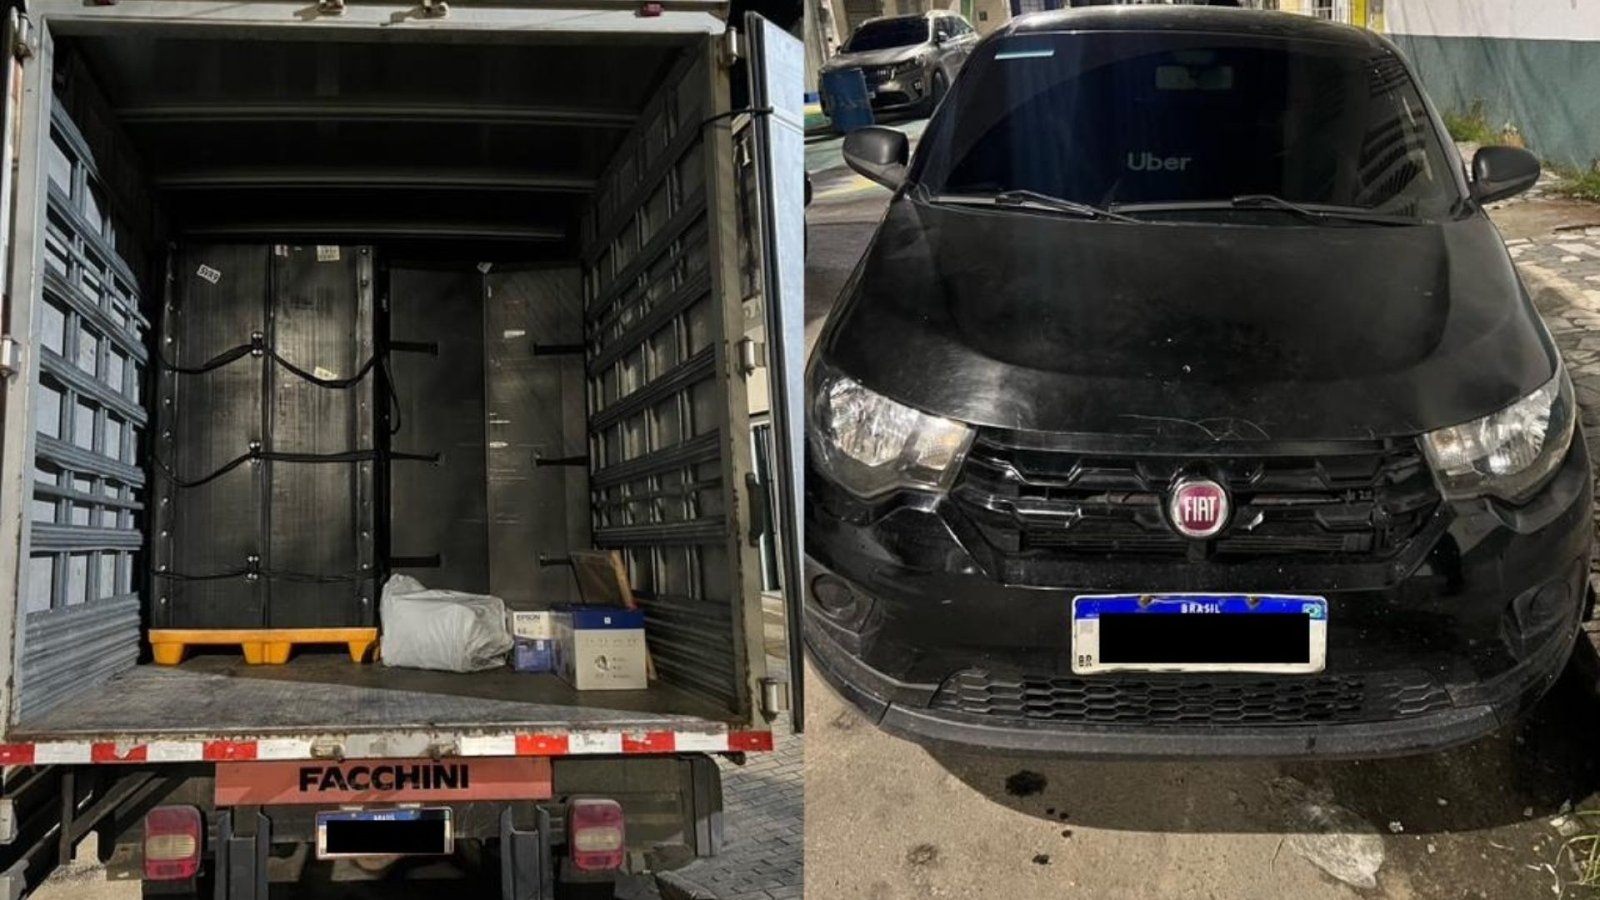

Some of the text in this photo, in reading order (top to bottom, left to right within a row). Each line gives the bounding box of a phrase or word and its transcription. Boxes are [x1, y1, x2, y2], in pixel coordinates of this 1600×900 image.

[1127, 152, 1192, 171] Uber
[1183, 496, 1217, 522] FIAT
[516, 613, 541, 621] EPSON
[1181, 603, 1221, 614] BRASIL
[299, 764, 469, 792] FACCHINI
